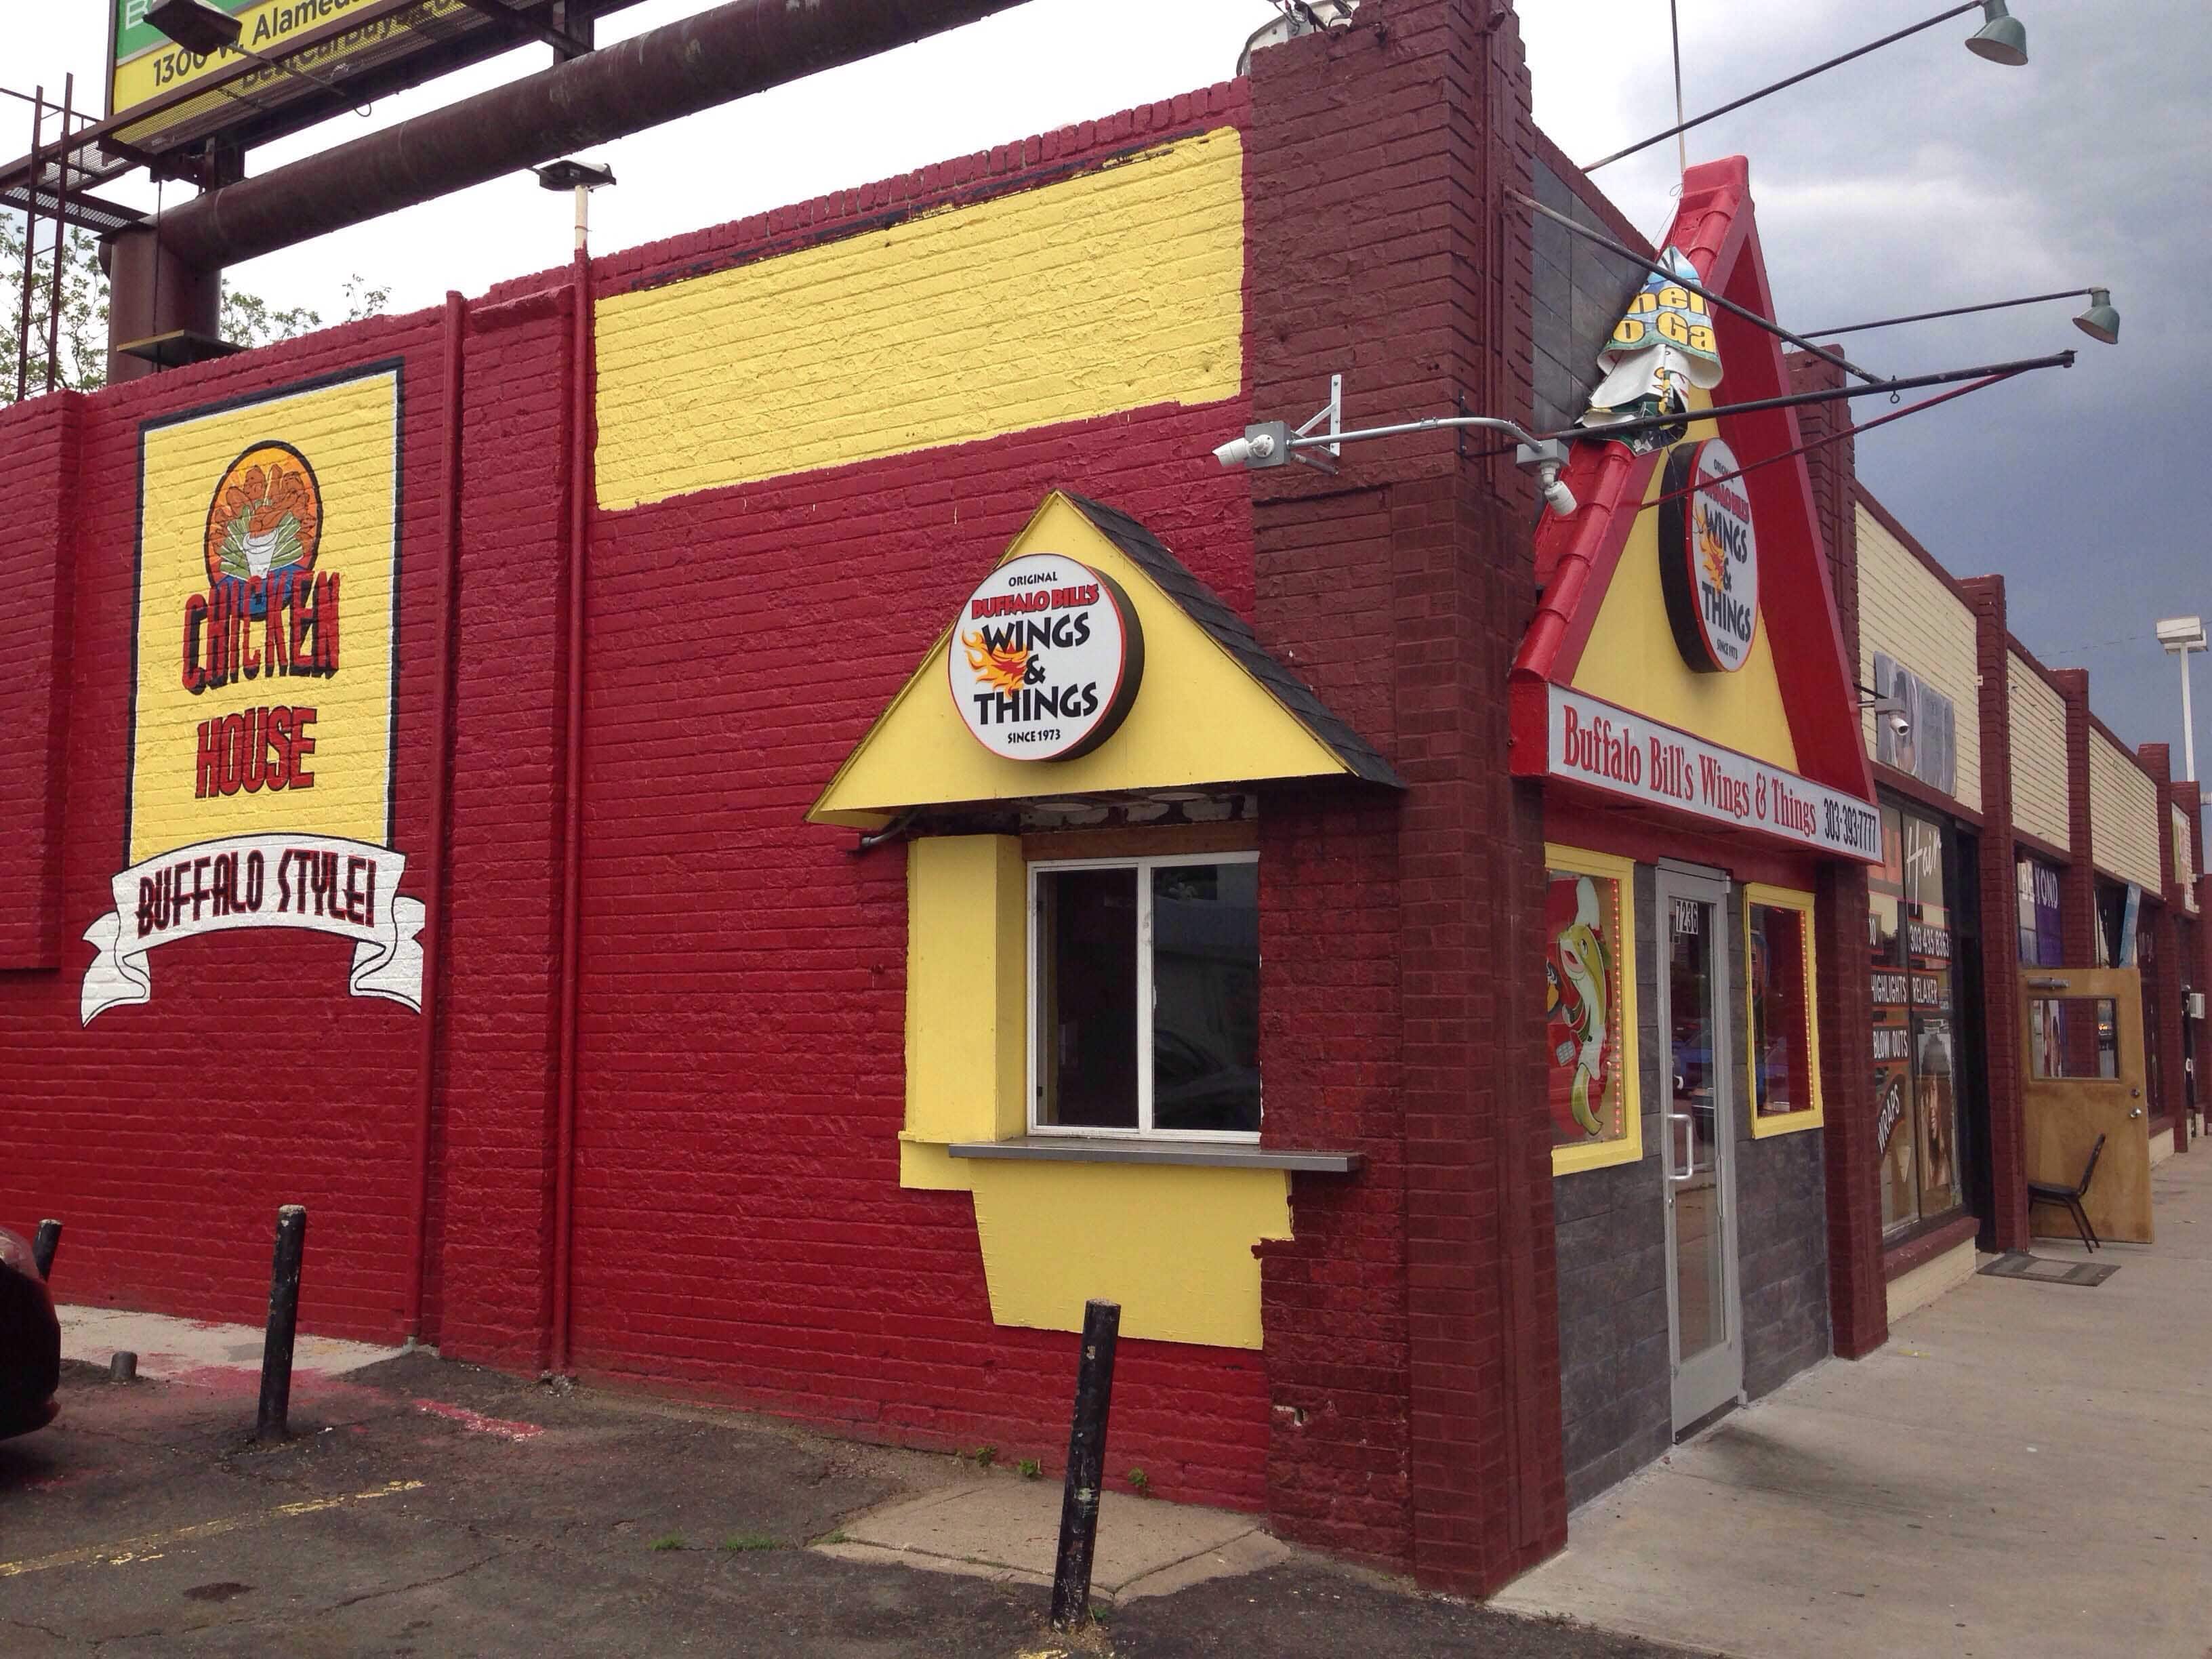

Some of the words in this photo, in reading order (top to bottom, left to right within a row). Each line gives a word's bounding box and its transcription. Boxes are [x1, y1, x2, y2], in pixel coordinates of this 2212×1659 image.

[252, 0, 361, 46] Alame
[1704, 504, 1747, 564] WINGS
[1008, 571, 1057, 587] ORIGINAL
[1723, 558, 1732, 592] &
[971, 591, 1050, 619] BUFFALO
[1702, 581, 1751, 642] THINGS
[182, 571, 340, 695] CHICKEN
[982, 612, 1090, 654] WINGS
[1023, 654, 1046, 684] &
[974, 682, 1098, 724] THINGS
[195, 705, 317, 798] HOUSE
[1008, 731, 1036, 743] SINCE
[1038, 729, 1061, 741] 1973
[1563, 705, 1641, 785] Buffalo
[1650, 736, 1694, 800] Bill's
[1699, 754, 1750, 819] Wings
[1756, 772, 1767, 820] &
[1771, 777, 1816, 837] Things
[1907, 819, 1942, 915] Hair
[2022, 862, 2058, 909] BEYOND
[136, 850, 264, 939] BUFFALO
[1676, 900, 1698, 933] 7236
[1910, 925, 1921, 952] 303
[1871, 975, 1907, 1003] HIGHLIGHTS
[1912, 977, 1938, 1004] RELAXER
[1873, 1031, 1889, 1059] BLOW
[1892, 1030, 1908, 1057] OUTS
[1878, 1084, 1900, 1154] WRAPS
